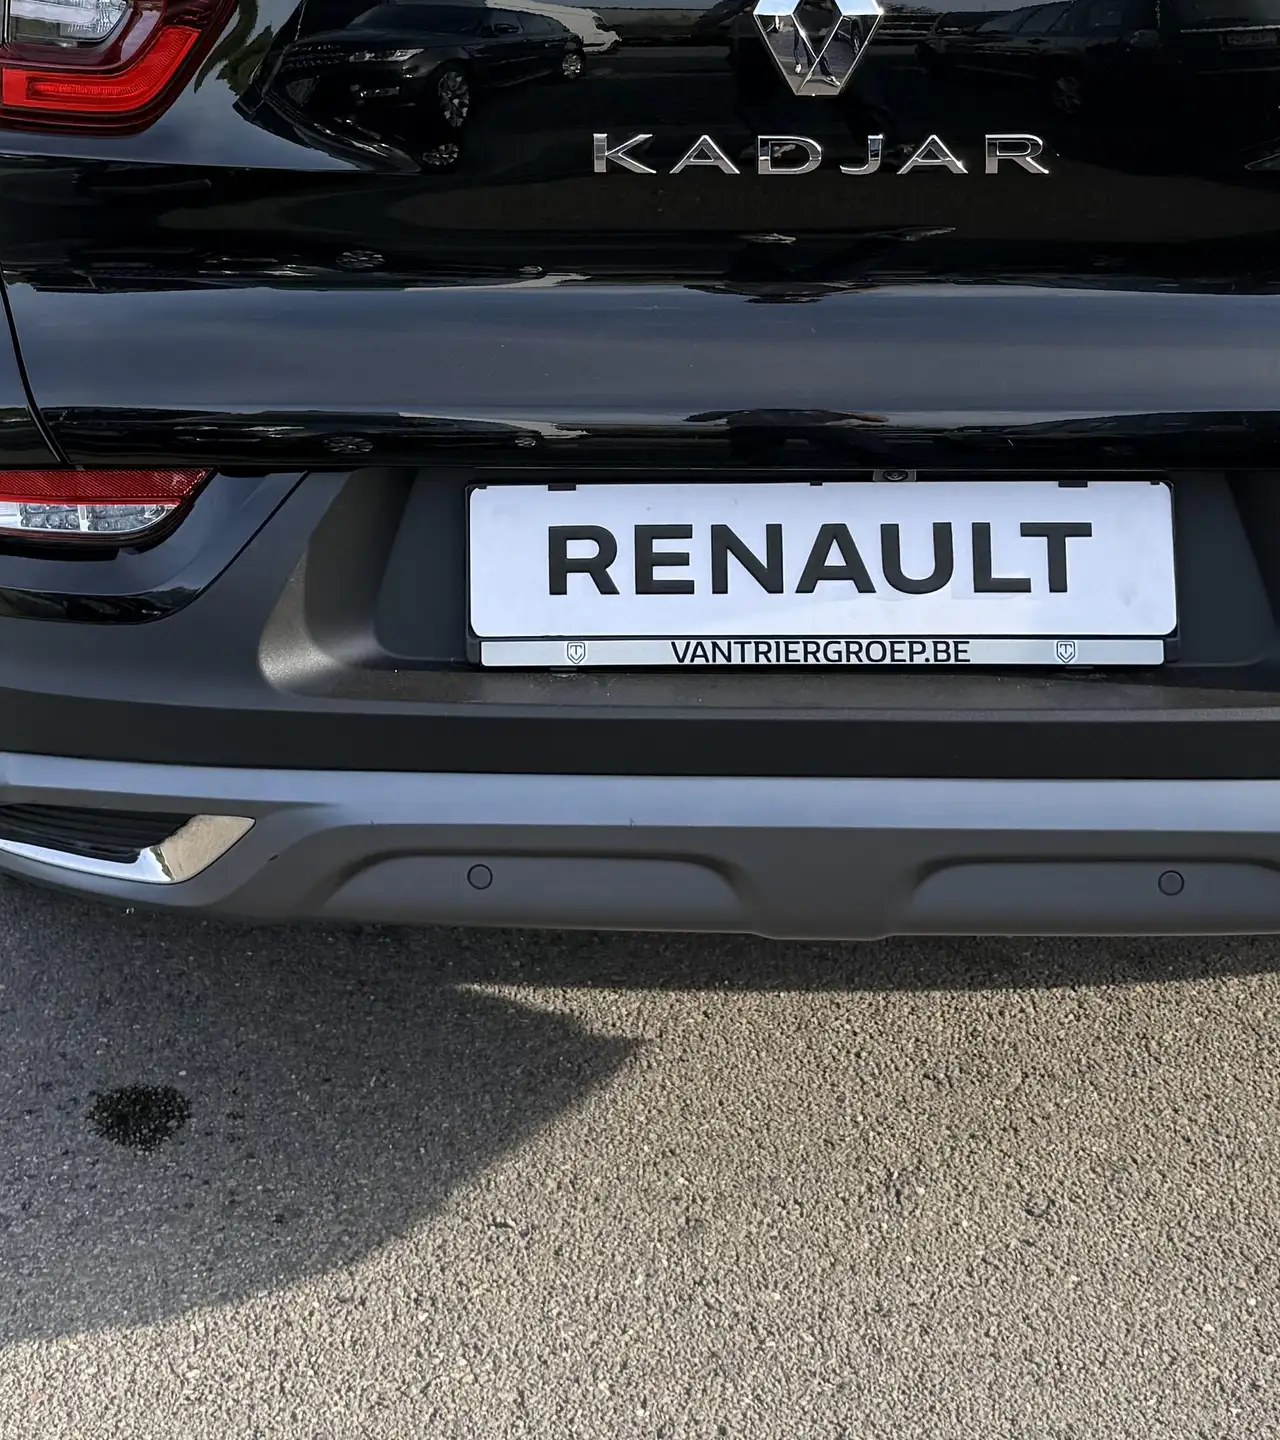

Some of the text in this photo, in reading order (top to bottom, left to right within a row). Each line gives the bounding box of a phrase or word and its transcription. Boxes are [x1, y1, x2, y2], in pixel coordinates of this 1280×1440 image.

[592, 133, 1050, 176] KADJAR
[547, 521, 1094, 596] RENAULT
[670, 639, 971, 664] VANTRIERGROEP.BE
